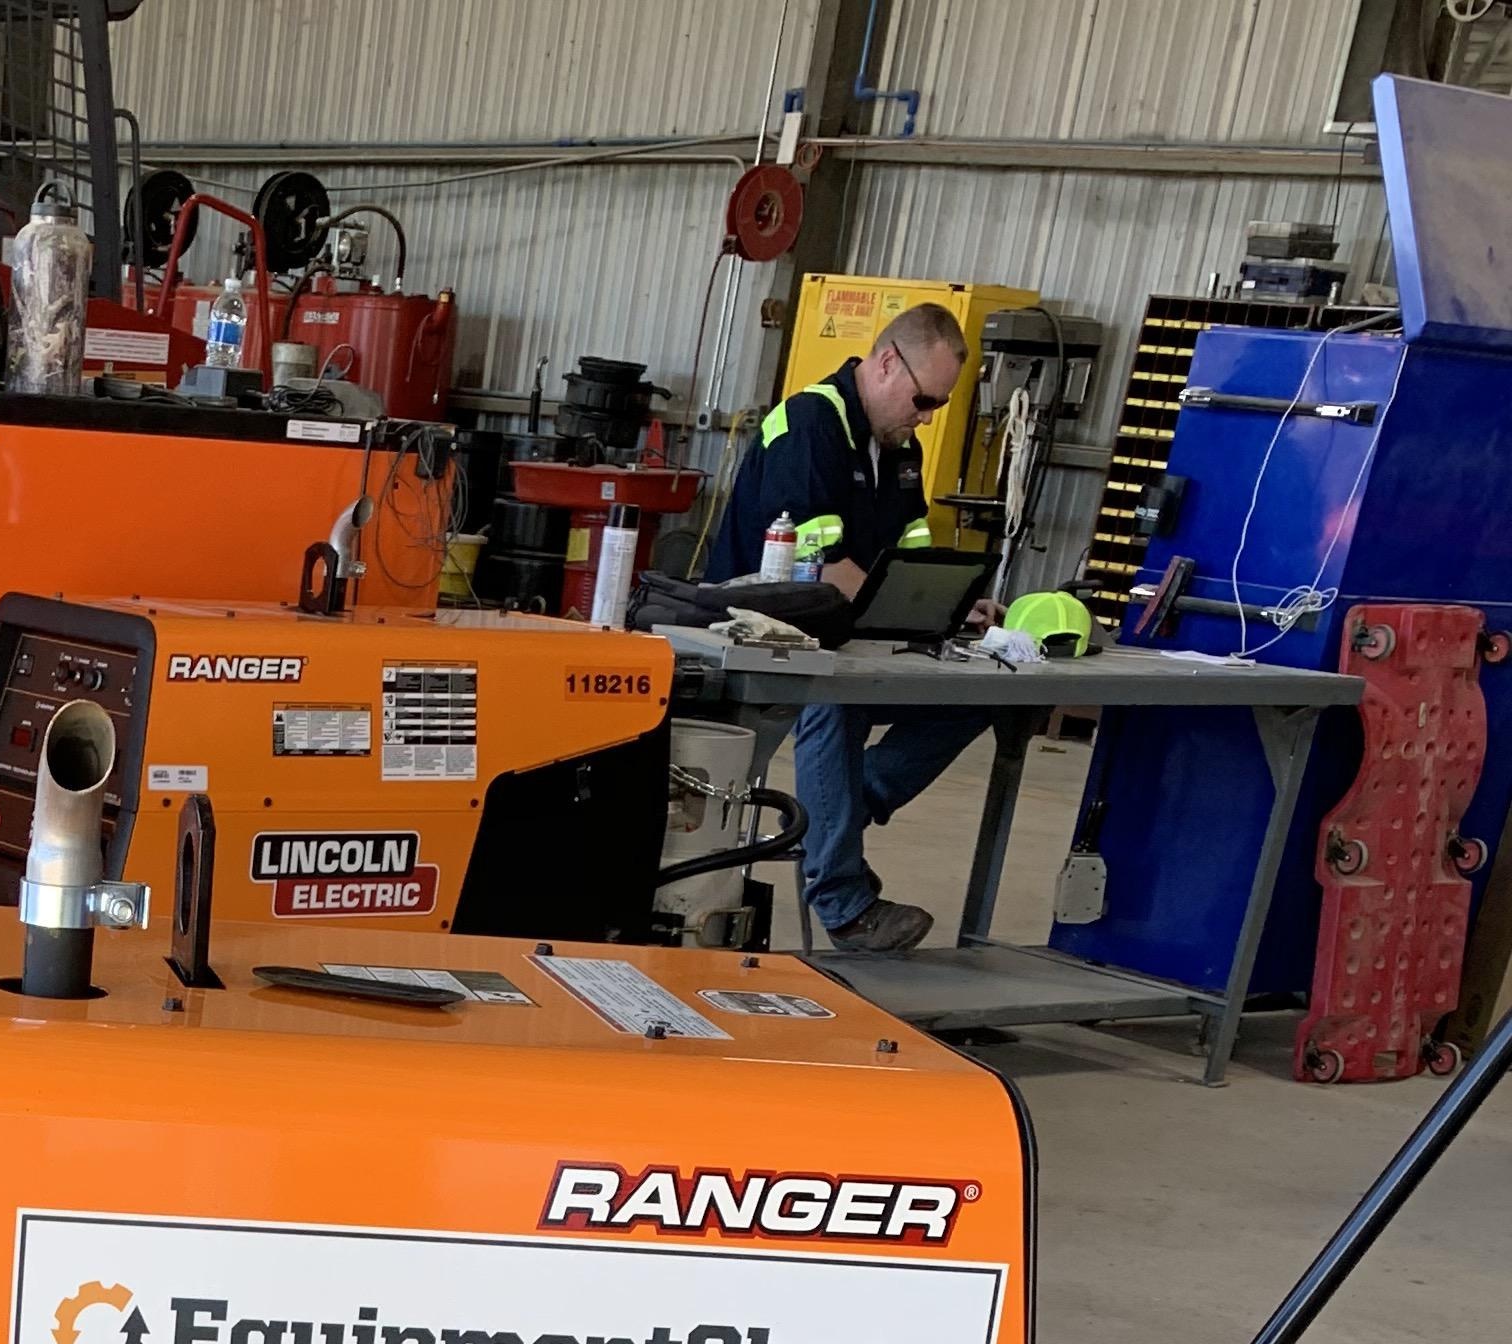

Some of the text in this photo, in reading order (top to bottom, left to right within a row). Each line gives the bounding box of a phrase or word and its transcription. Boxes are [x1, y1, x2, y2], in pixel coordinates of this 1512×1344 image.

[169, 656, 302, 681] RANGER
[565, 673, 650, 695] 118216
[260, 839, 410, 876] LINCOLN
[292, 881, 421, 911] ELECTRIC
[548, 1169, 955, 1242] RANGER
